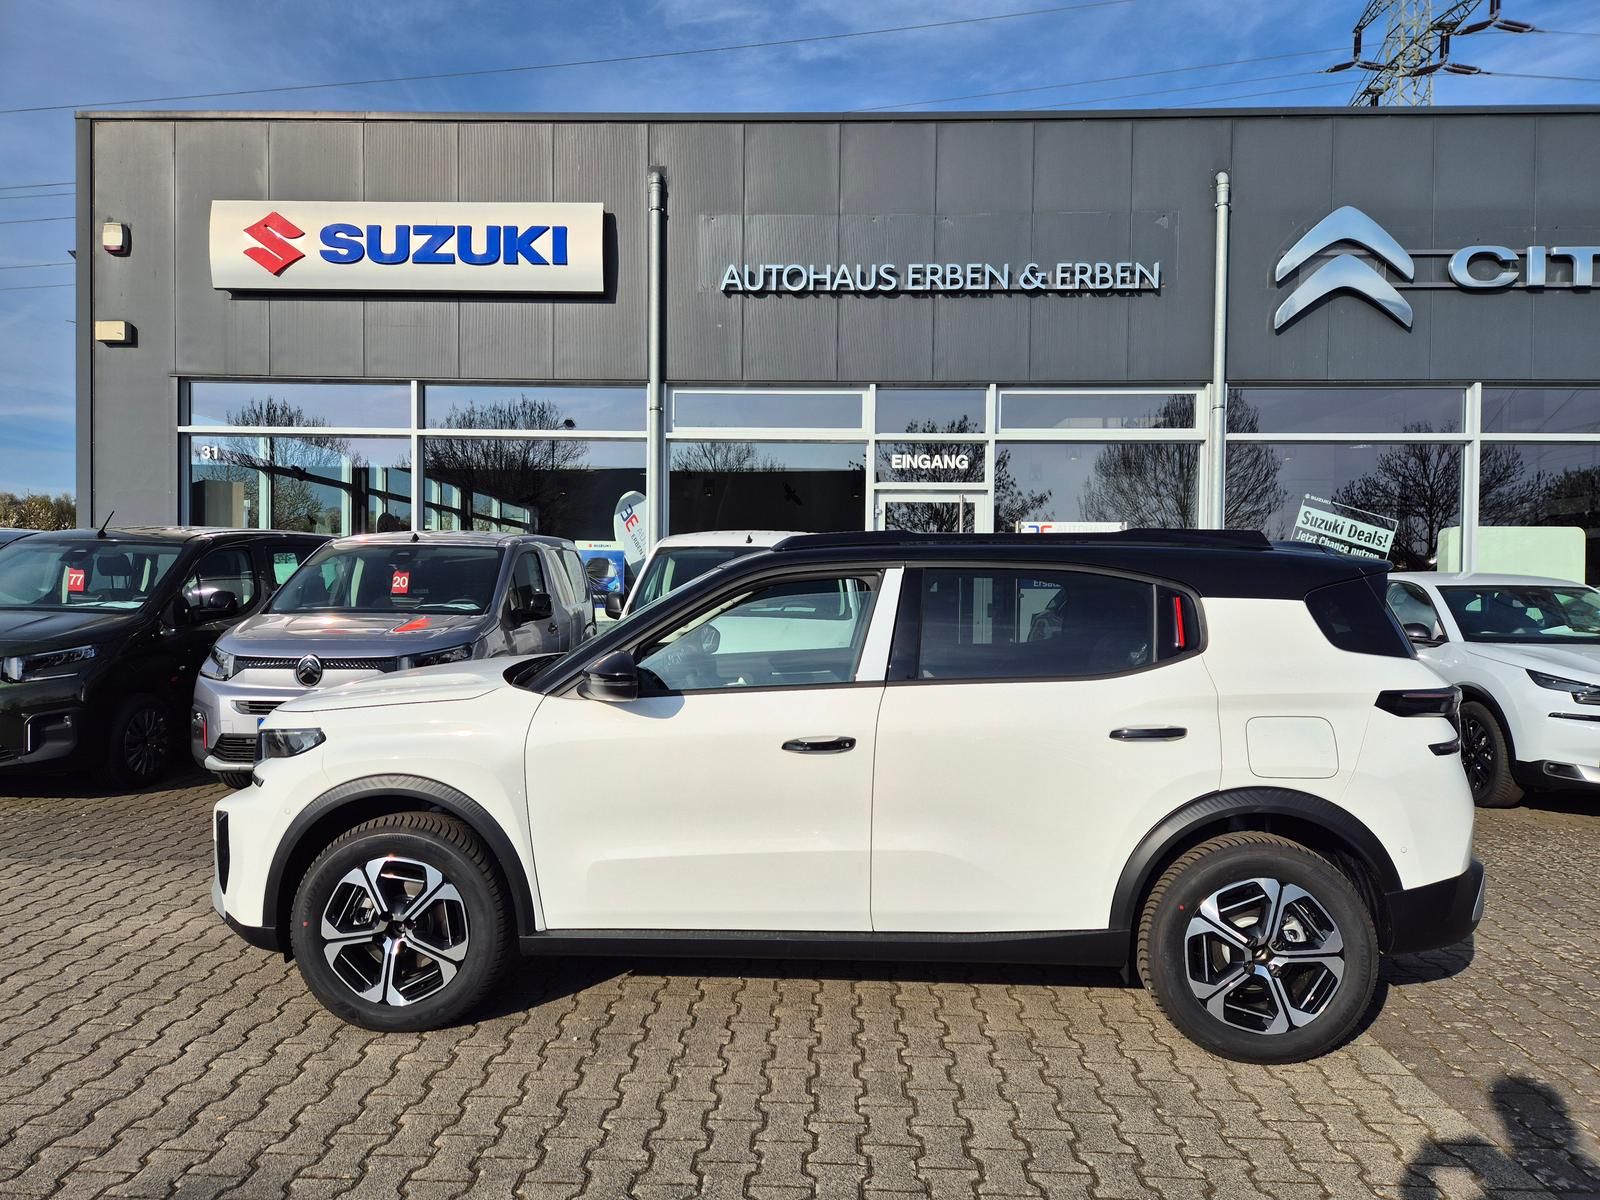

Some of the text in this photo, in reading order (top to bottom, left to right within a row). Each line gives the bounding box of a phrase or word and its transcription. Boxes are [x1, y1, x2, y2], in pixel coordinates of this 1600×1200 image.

[319, 223, 568, 266] SUZUKI
[720, 261, 1160, 292] AUTOHAUS ERBEN & ERBEN
[201, 445, 218, 460] 31
[891, 454, 969, 469] EINGANG
[1301, 510, 1390, 548] Suzuki Deals!
[1296, 530, 1318, 544] Jetzt
[1318, 536, 1350, 554] Chance
[69, 573, 84, 586] 77
[392, 576, 409, 588] 20
